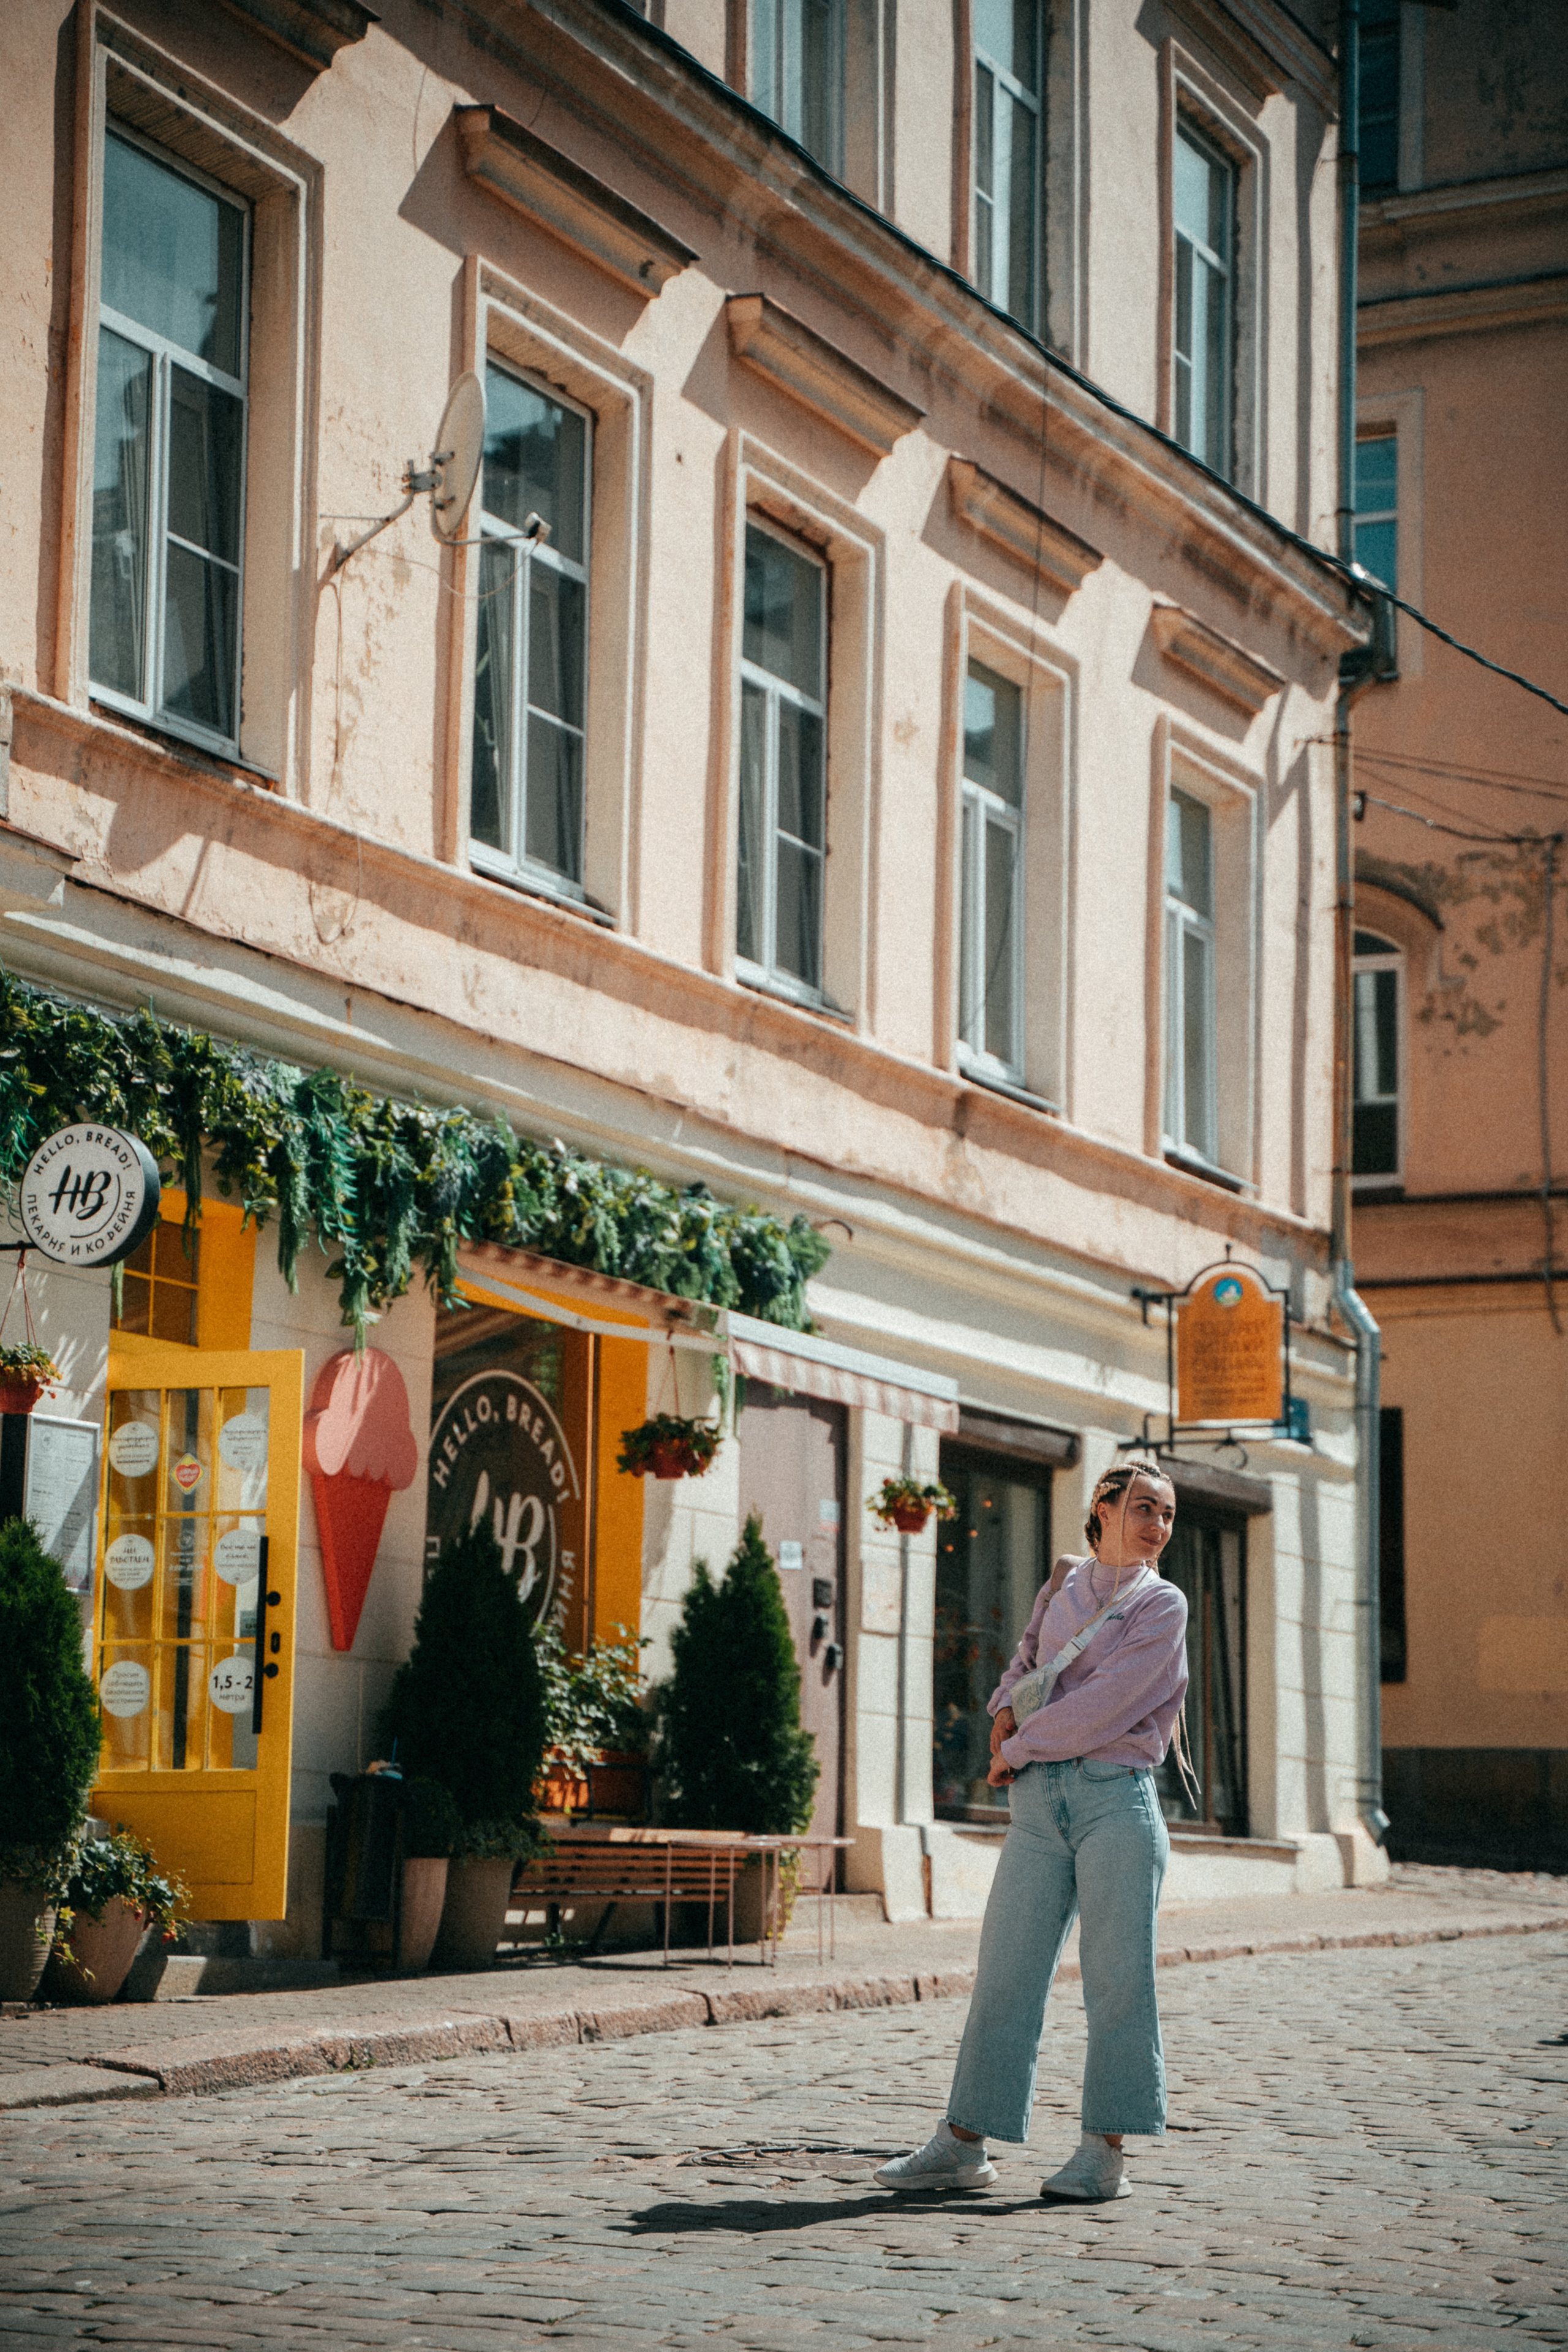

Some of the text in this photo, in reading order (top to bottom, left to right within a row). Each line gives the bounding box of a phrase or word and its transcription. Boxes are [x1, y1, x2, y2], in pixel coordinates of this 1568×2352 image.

[34, 1131, 132, 1175] HELLO, BREAD!
[48, 1164, 111, 1220] HB
[433, 1394, 570, 1503] HELLO, BREAD!
[213, 1675, 233, 1691] 1,5
[244, 1675, 253, 1689] 2
